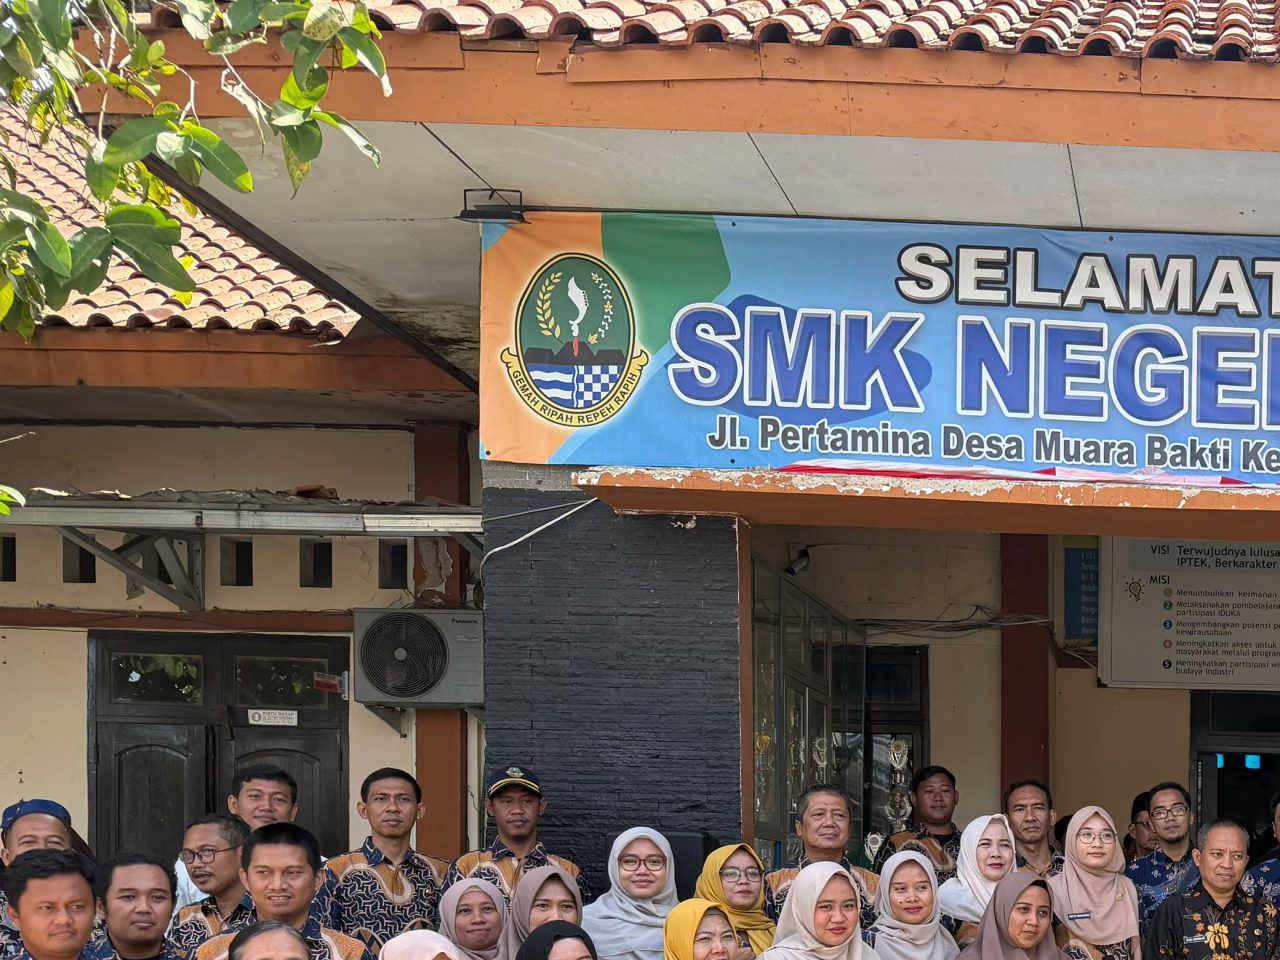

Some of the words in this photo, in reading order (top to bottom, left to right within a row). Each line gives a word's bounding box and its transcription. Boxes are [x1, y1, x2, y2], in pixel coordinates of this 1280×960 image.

[669, 303, 926, 413] SMK
[512, 370, 539, 407] GEMAH
[539, 404, 573, 424] RIPAH
[577, 405, 615, 424] REPEH
[615, 372, 637, 406] RAPIH
[709, 415, 748, 450] Jl.
[759, 418, 930, 458] Pertamina
[942, 426, 1023, 461] Desa
[1034, 429, 1135, 466] Muara
[1146, 435, 1230, 472] Bakti
[1150, 545, 1170, 555] VISI
[1177, 545, 1245, 558] Terwujudnya
[1177, 557, 1211, 568] IPTEK,
[1215, 558, 1277, 568] Berkarakter
[1149, 575, 1170, 585] MISI
